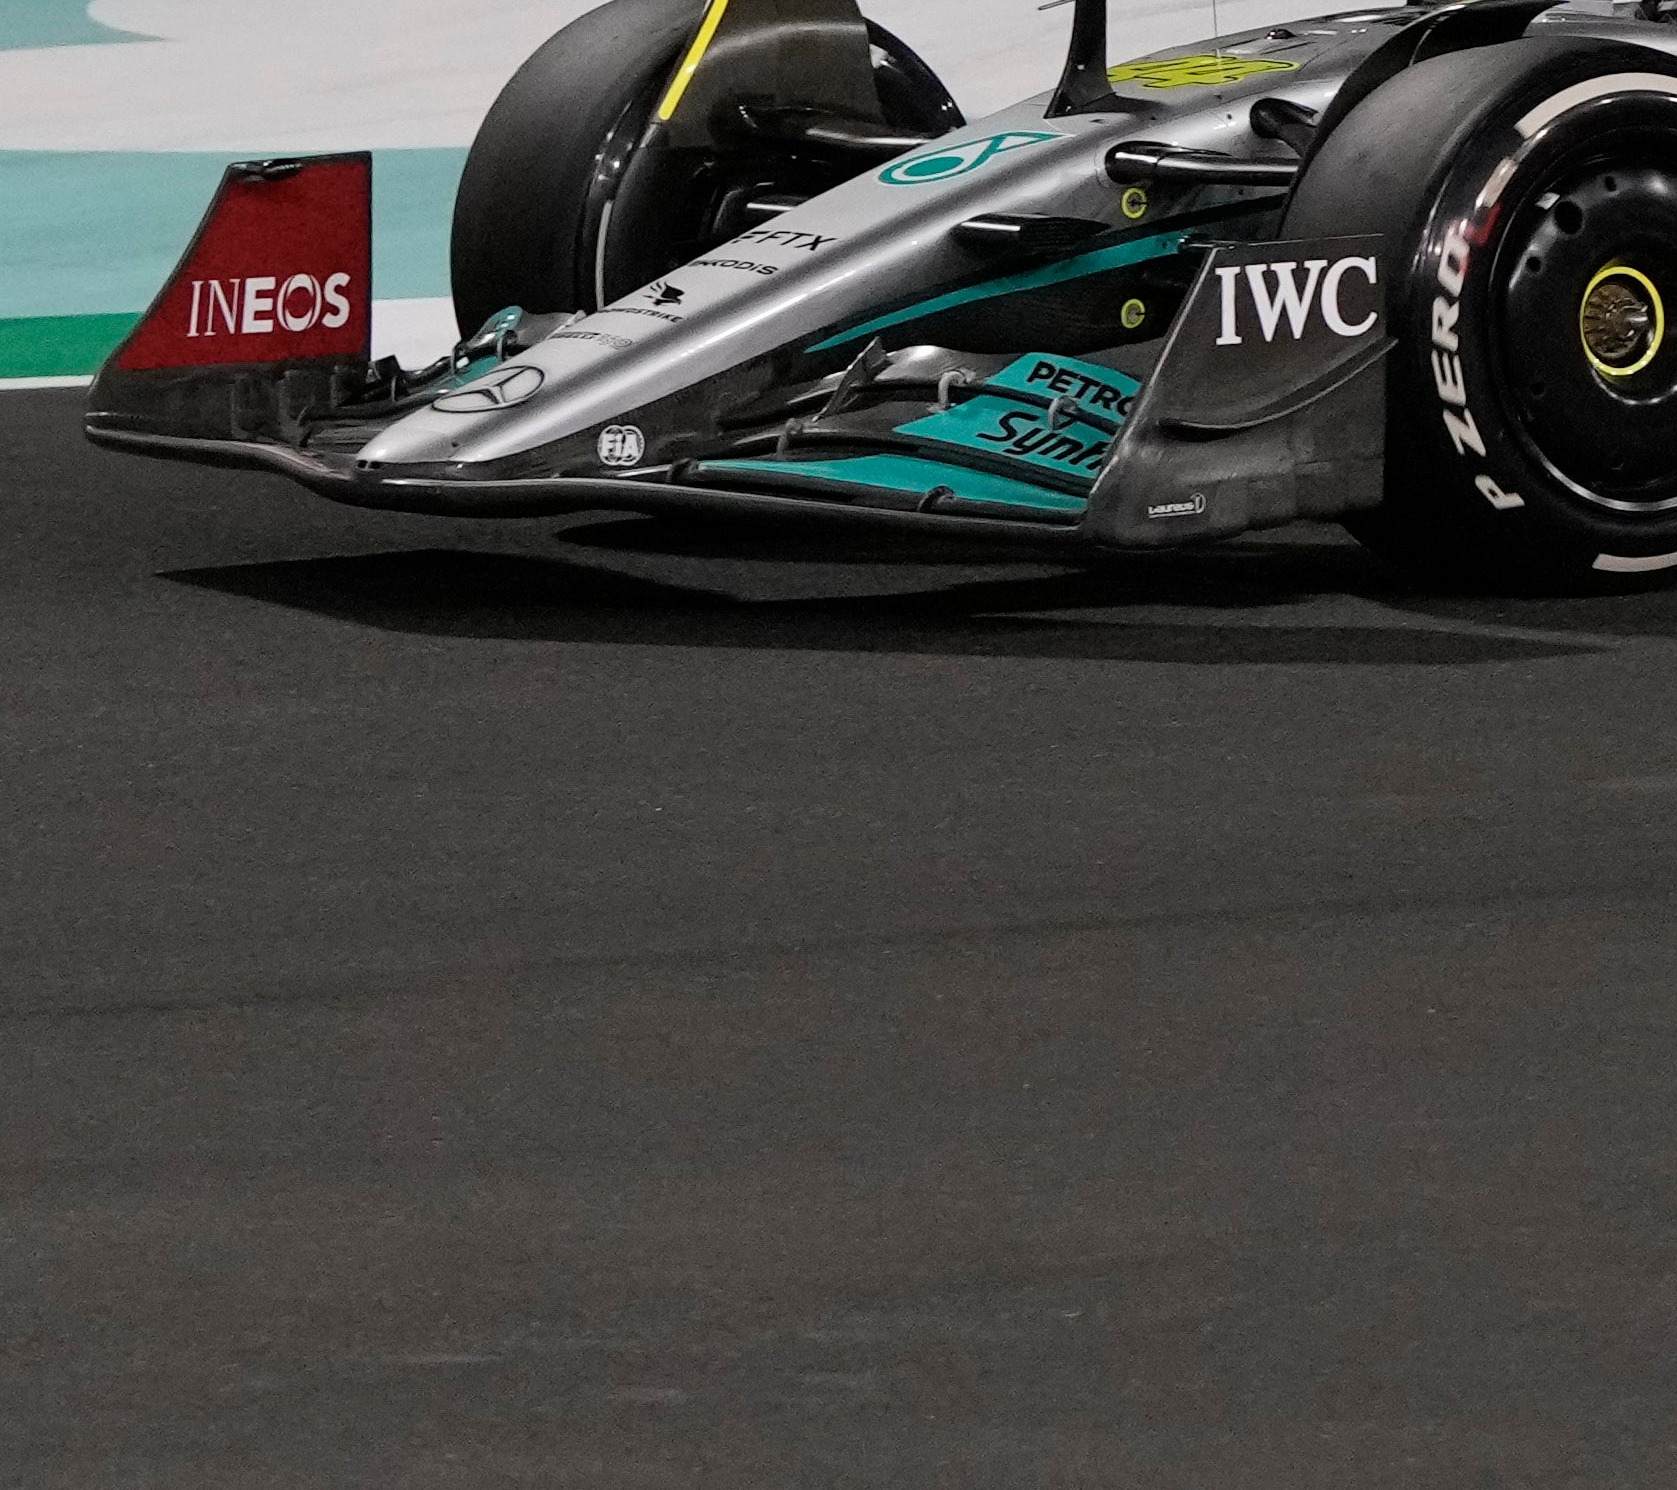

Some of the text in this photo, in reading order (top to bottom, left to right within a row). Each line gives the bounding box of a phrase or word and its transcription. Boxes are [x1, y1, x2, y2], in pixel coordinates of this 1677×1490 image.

[758, 230, 839, 252] FTX
[187, 271, 351, 338] INEOS
[1214, 254, 1380, 348] IWC
[1429, 229, 1526, 511] P ZERO
